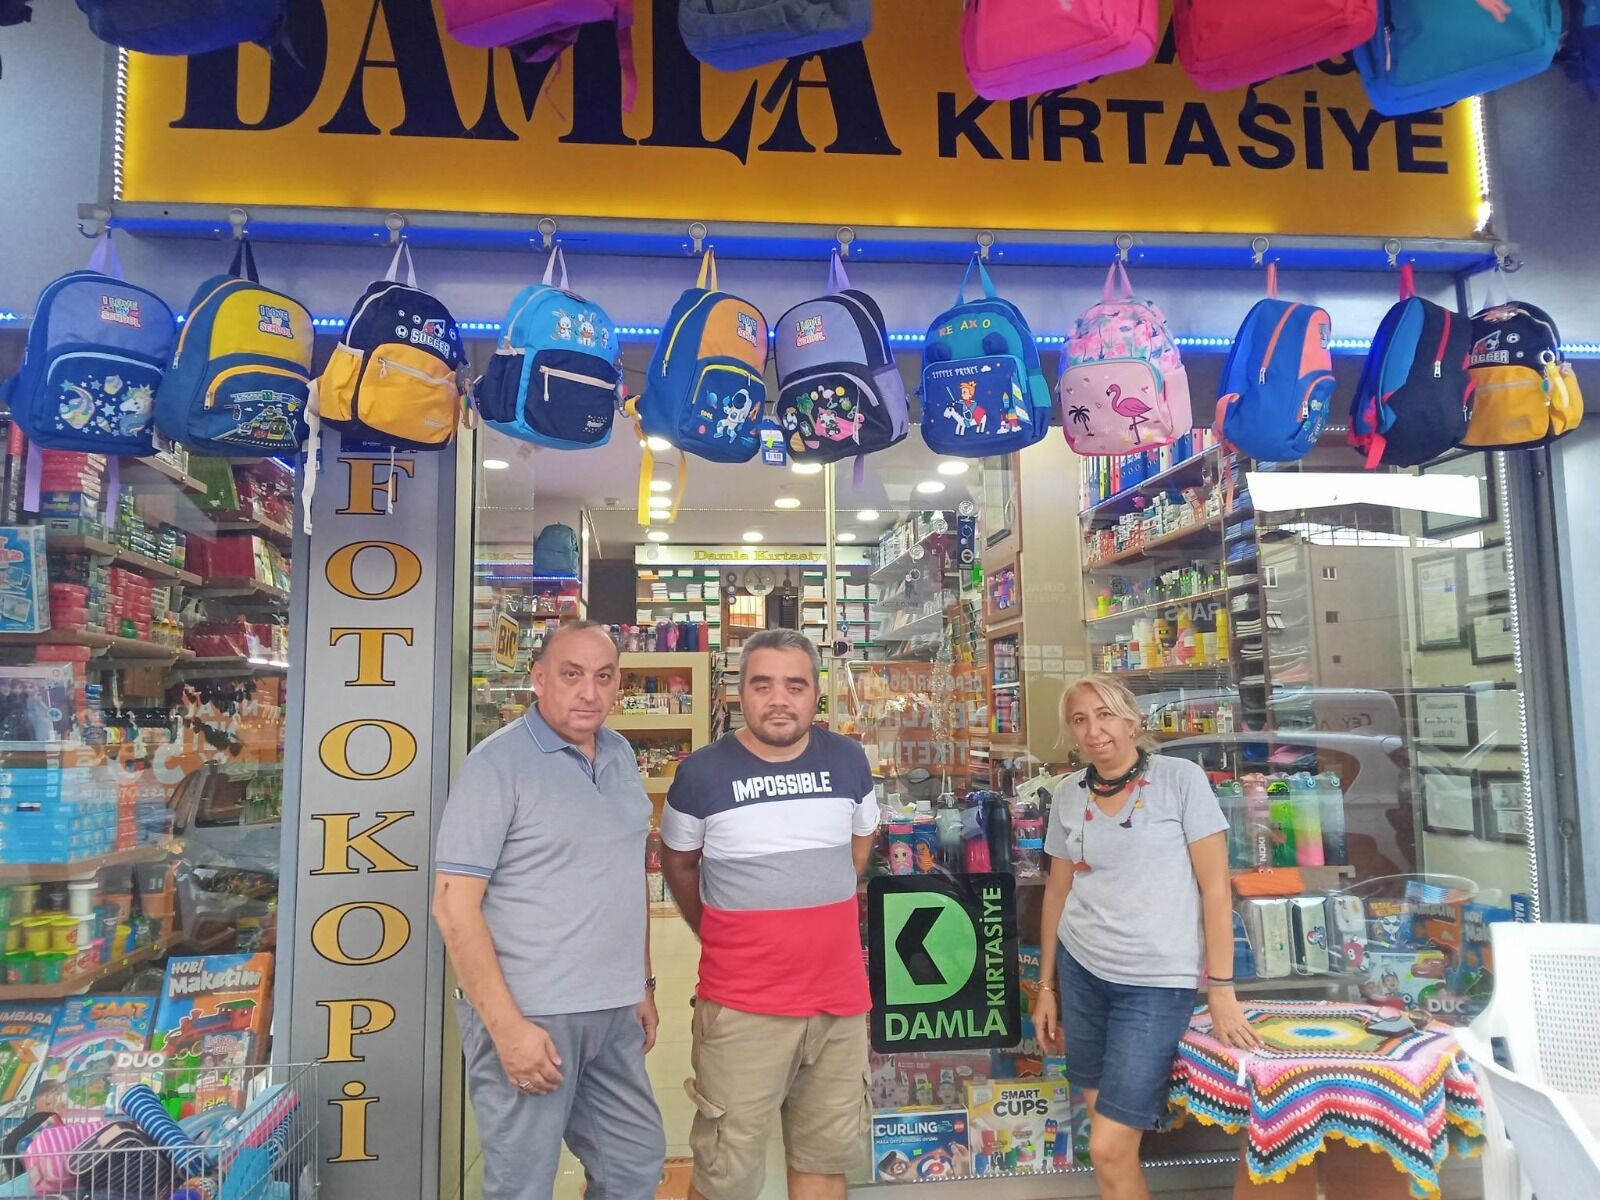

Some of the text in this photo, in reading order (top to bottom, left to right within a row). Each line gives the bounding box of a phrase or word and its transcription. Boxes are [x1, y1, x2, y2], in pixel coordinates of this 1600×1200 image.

[936, 91, 1449, 174] KIRTASİYE
[410, 328, 451, 359] SOCCER
[931, 365, 979, 378] LITTLE PRINCE
[693, 550, 827, 563] Damla Kırtasiy
[498, 624, 517, 660] BIC
[732, 771, 833, 803] IMPOSSIBLE
[309, 457, 423, 1164] FOTOKOPİ
[979, 887, 1006, 1006] KIRTASİYE
[885, 1008, 1008, 1042] DAMLA
[117, 1053, 164, 1068] DUO
[992, 1099, 1049, 1118] CUPS
[1001, 1089, 1041, 1101] SMART
[876, 1121, 939, 1138] CURLING
